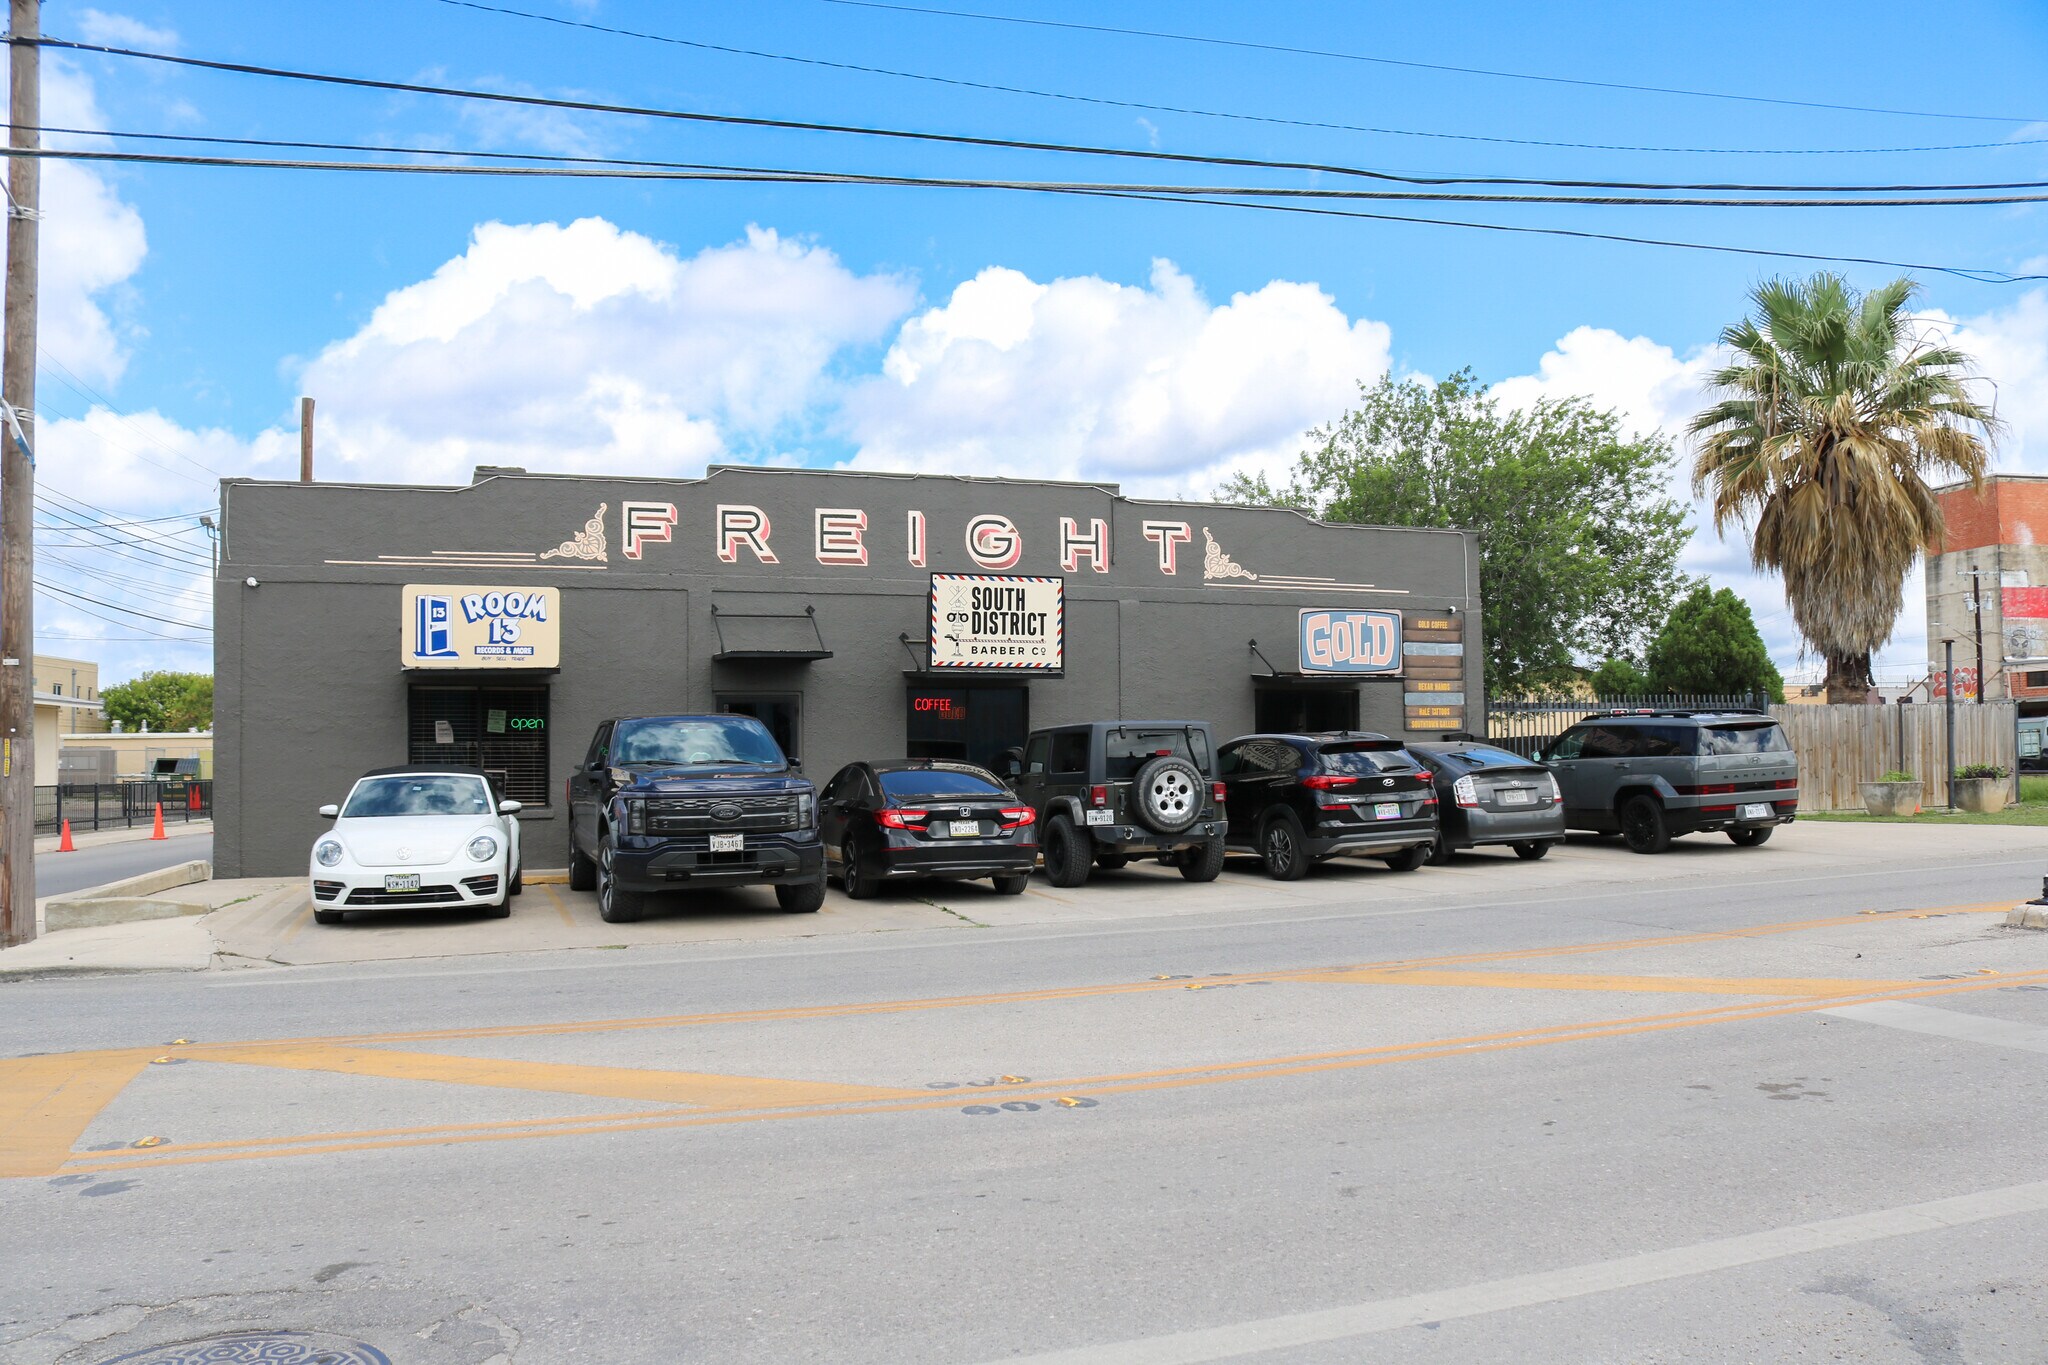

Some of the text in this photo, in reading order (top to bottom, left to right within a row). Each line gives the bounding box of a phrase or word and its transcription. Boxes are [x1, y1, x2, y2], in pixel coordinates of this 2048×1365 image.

[622, 501, 1191, 575] FREIGHT
[460, 592, 547, 623] ROOM
[971, 586, 1026, 611] SOUTH
[433, 607, 446, 618] 13
[488, 618, 521, 644] 13
[971, 611, 1047, 636] DISTRICT
[1417, 620, 1448, 629] GOLD COFFEE
[1306, 614, 1395, 667] GOLD
[476, 646, 505, 654] RECORDS
[513, 647, 532, 655] MORE
[971, 646, 1025, 655] BARBER
[914, 698, 951, 711] COFFEE
[510, 718, 544, 731] open
